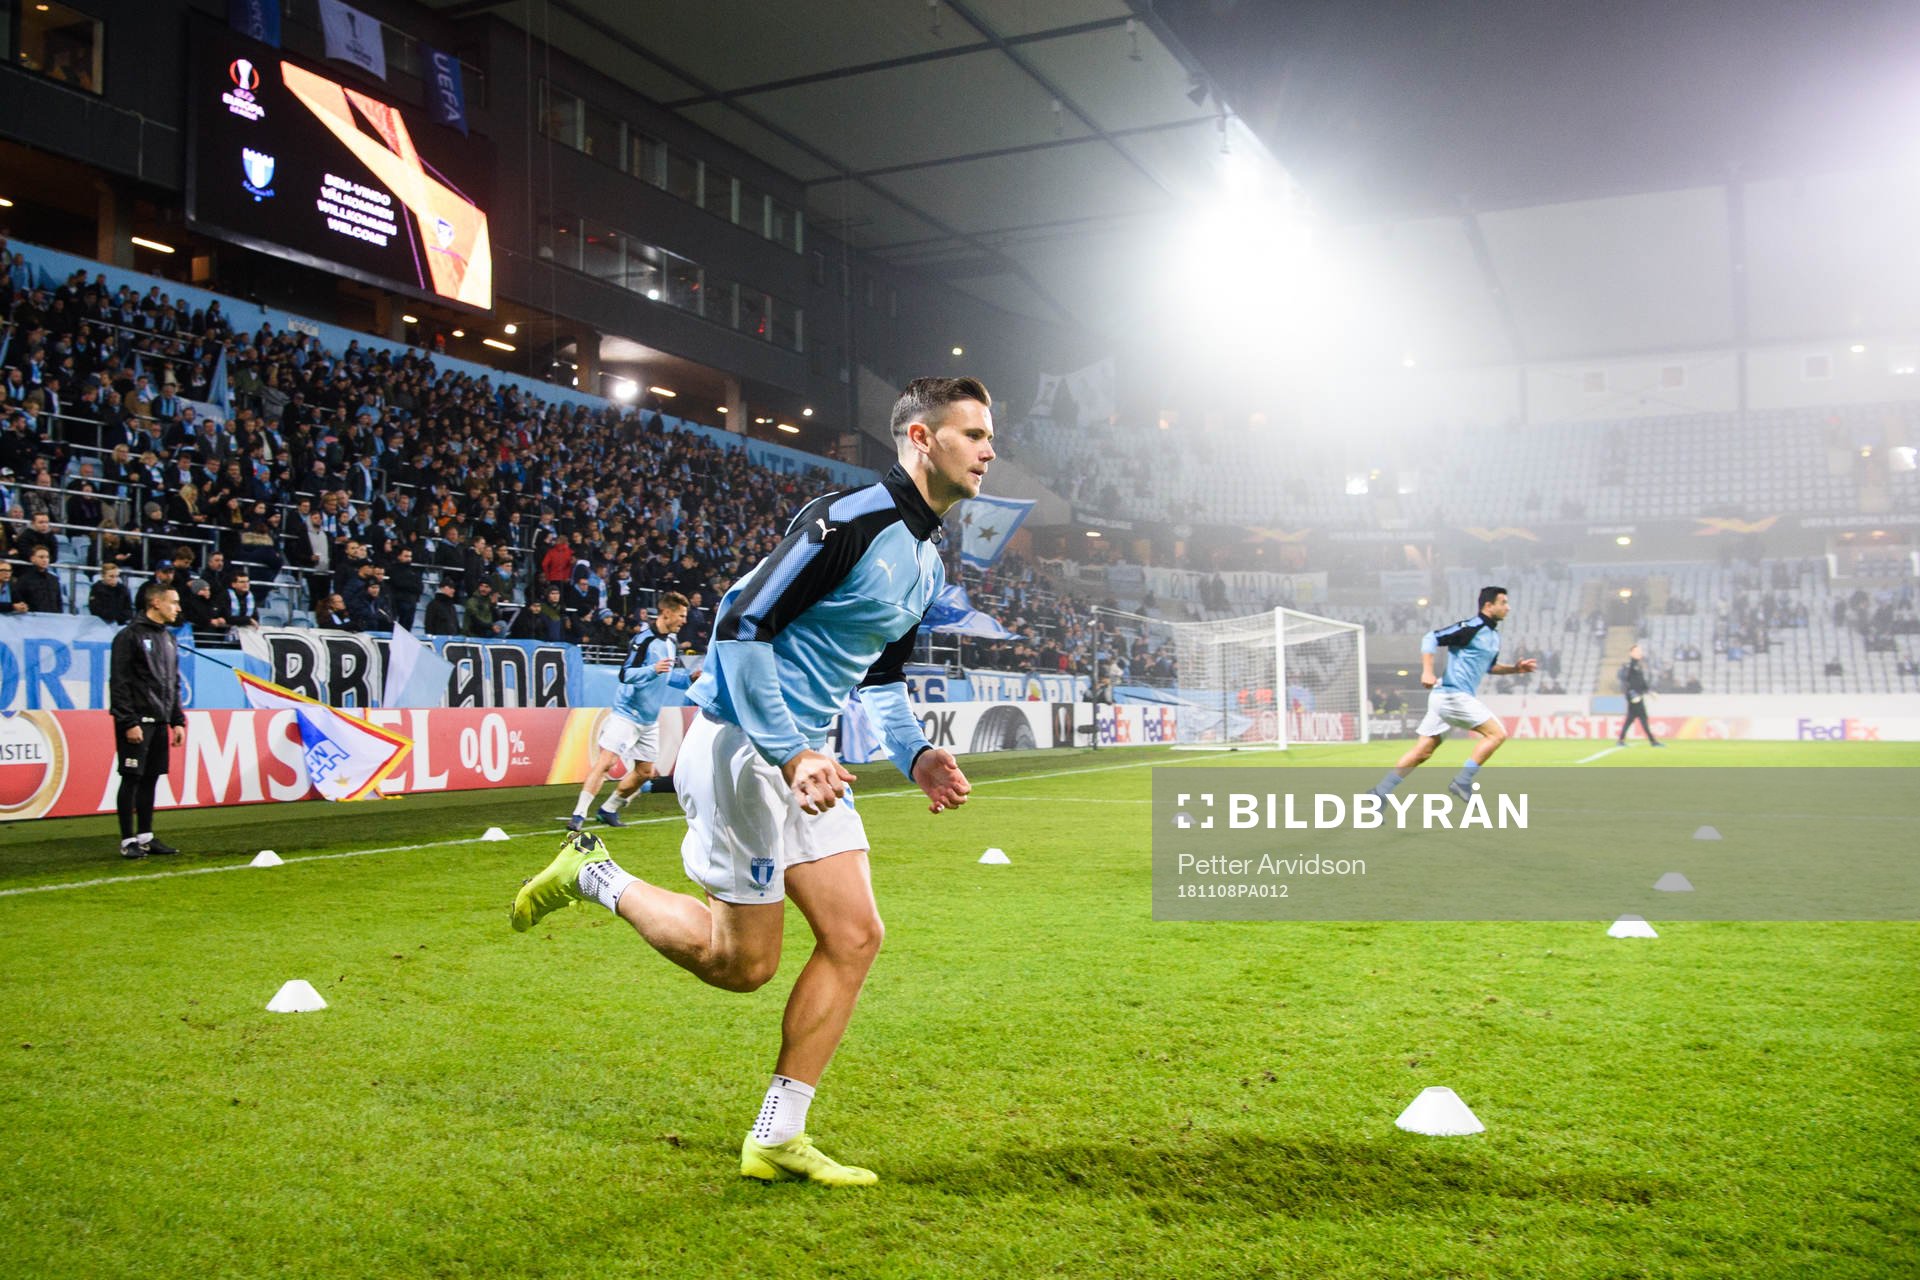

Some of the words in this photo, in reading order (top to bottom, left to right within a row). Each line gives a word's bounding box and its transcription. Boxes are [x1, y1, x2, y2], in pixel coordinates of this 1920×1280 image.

[432, 52, 461, 121] UEFA
[327, 217, 388, 247] WELCOME
[1797, 718, 1881, 741] FedEx
